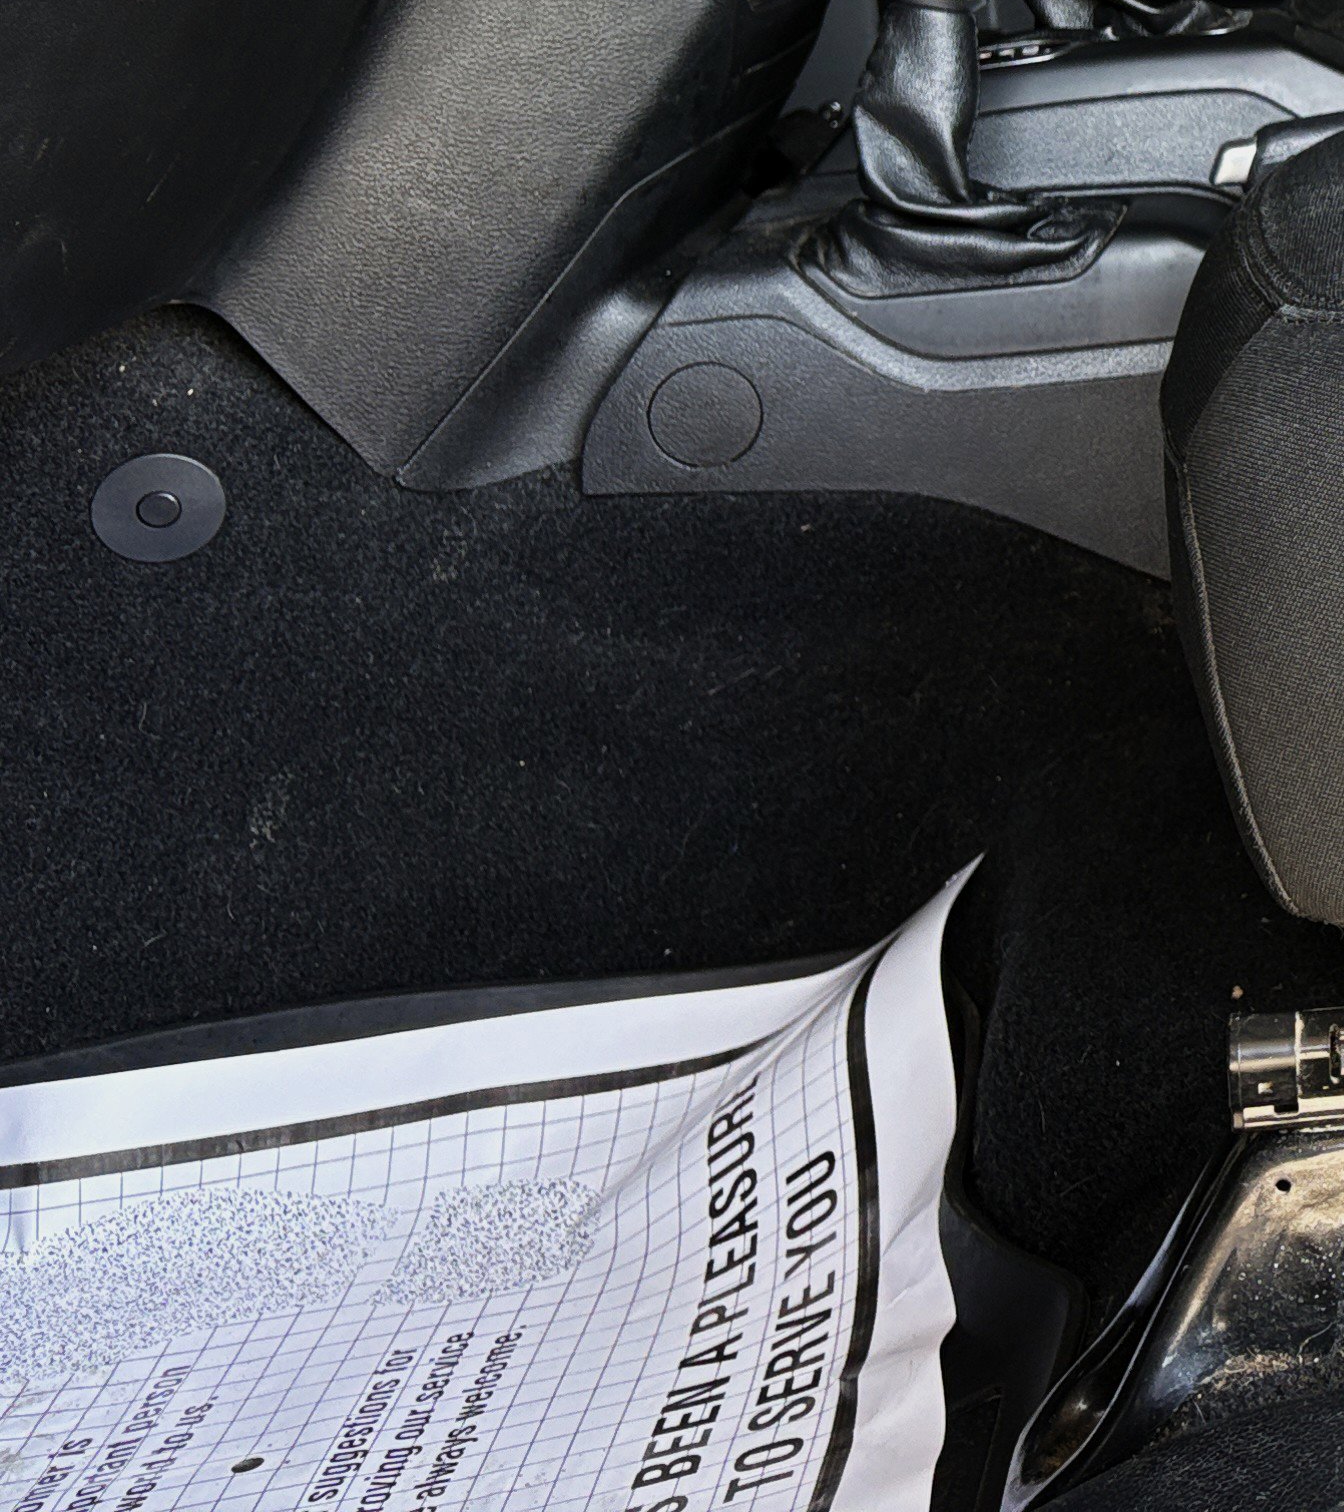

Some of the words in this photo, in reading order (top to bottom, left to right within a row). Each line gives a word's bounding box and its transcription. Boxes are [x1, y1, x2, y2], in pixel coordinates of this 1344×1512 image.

[784, 1150, 838, 1279] YOU
[121, 1365, 191, 1434] person
[395, 1408, 435, 1440] our
[416, 1331, 474, 1402] service
[678, 1333, 743, 1369] A
[747, 1269, 836, 1432] SERVE
[47, 1438, 93, 1459] is
[152, 1433, 194, 1454] to
[174, 1396, 219, 1427] us.
[307, 1379, 400, 1503] suggestions
[372, 1349, 417, 1375] for
[414, 1424, 478, 1500] always
[456, 1324, 527, 1422] welcome.
[630, 1376, 731, 1491] BEEN
[723, 1438, 804, 1504] TO
